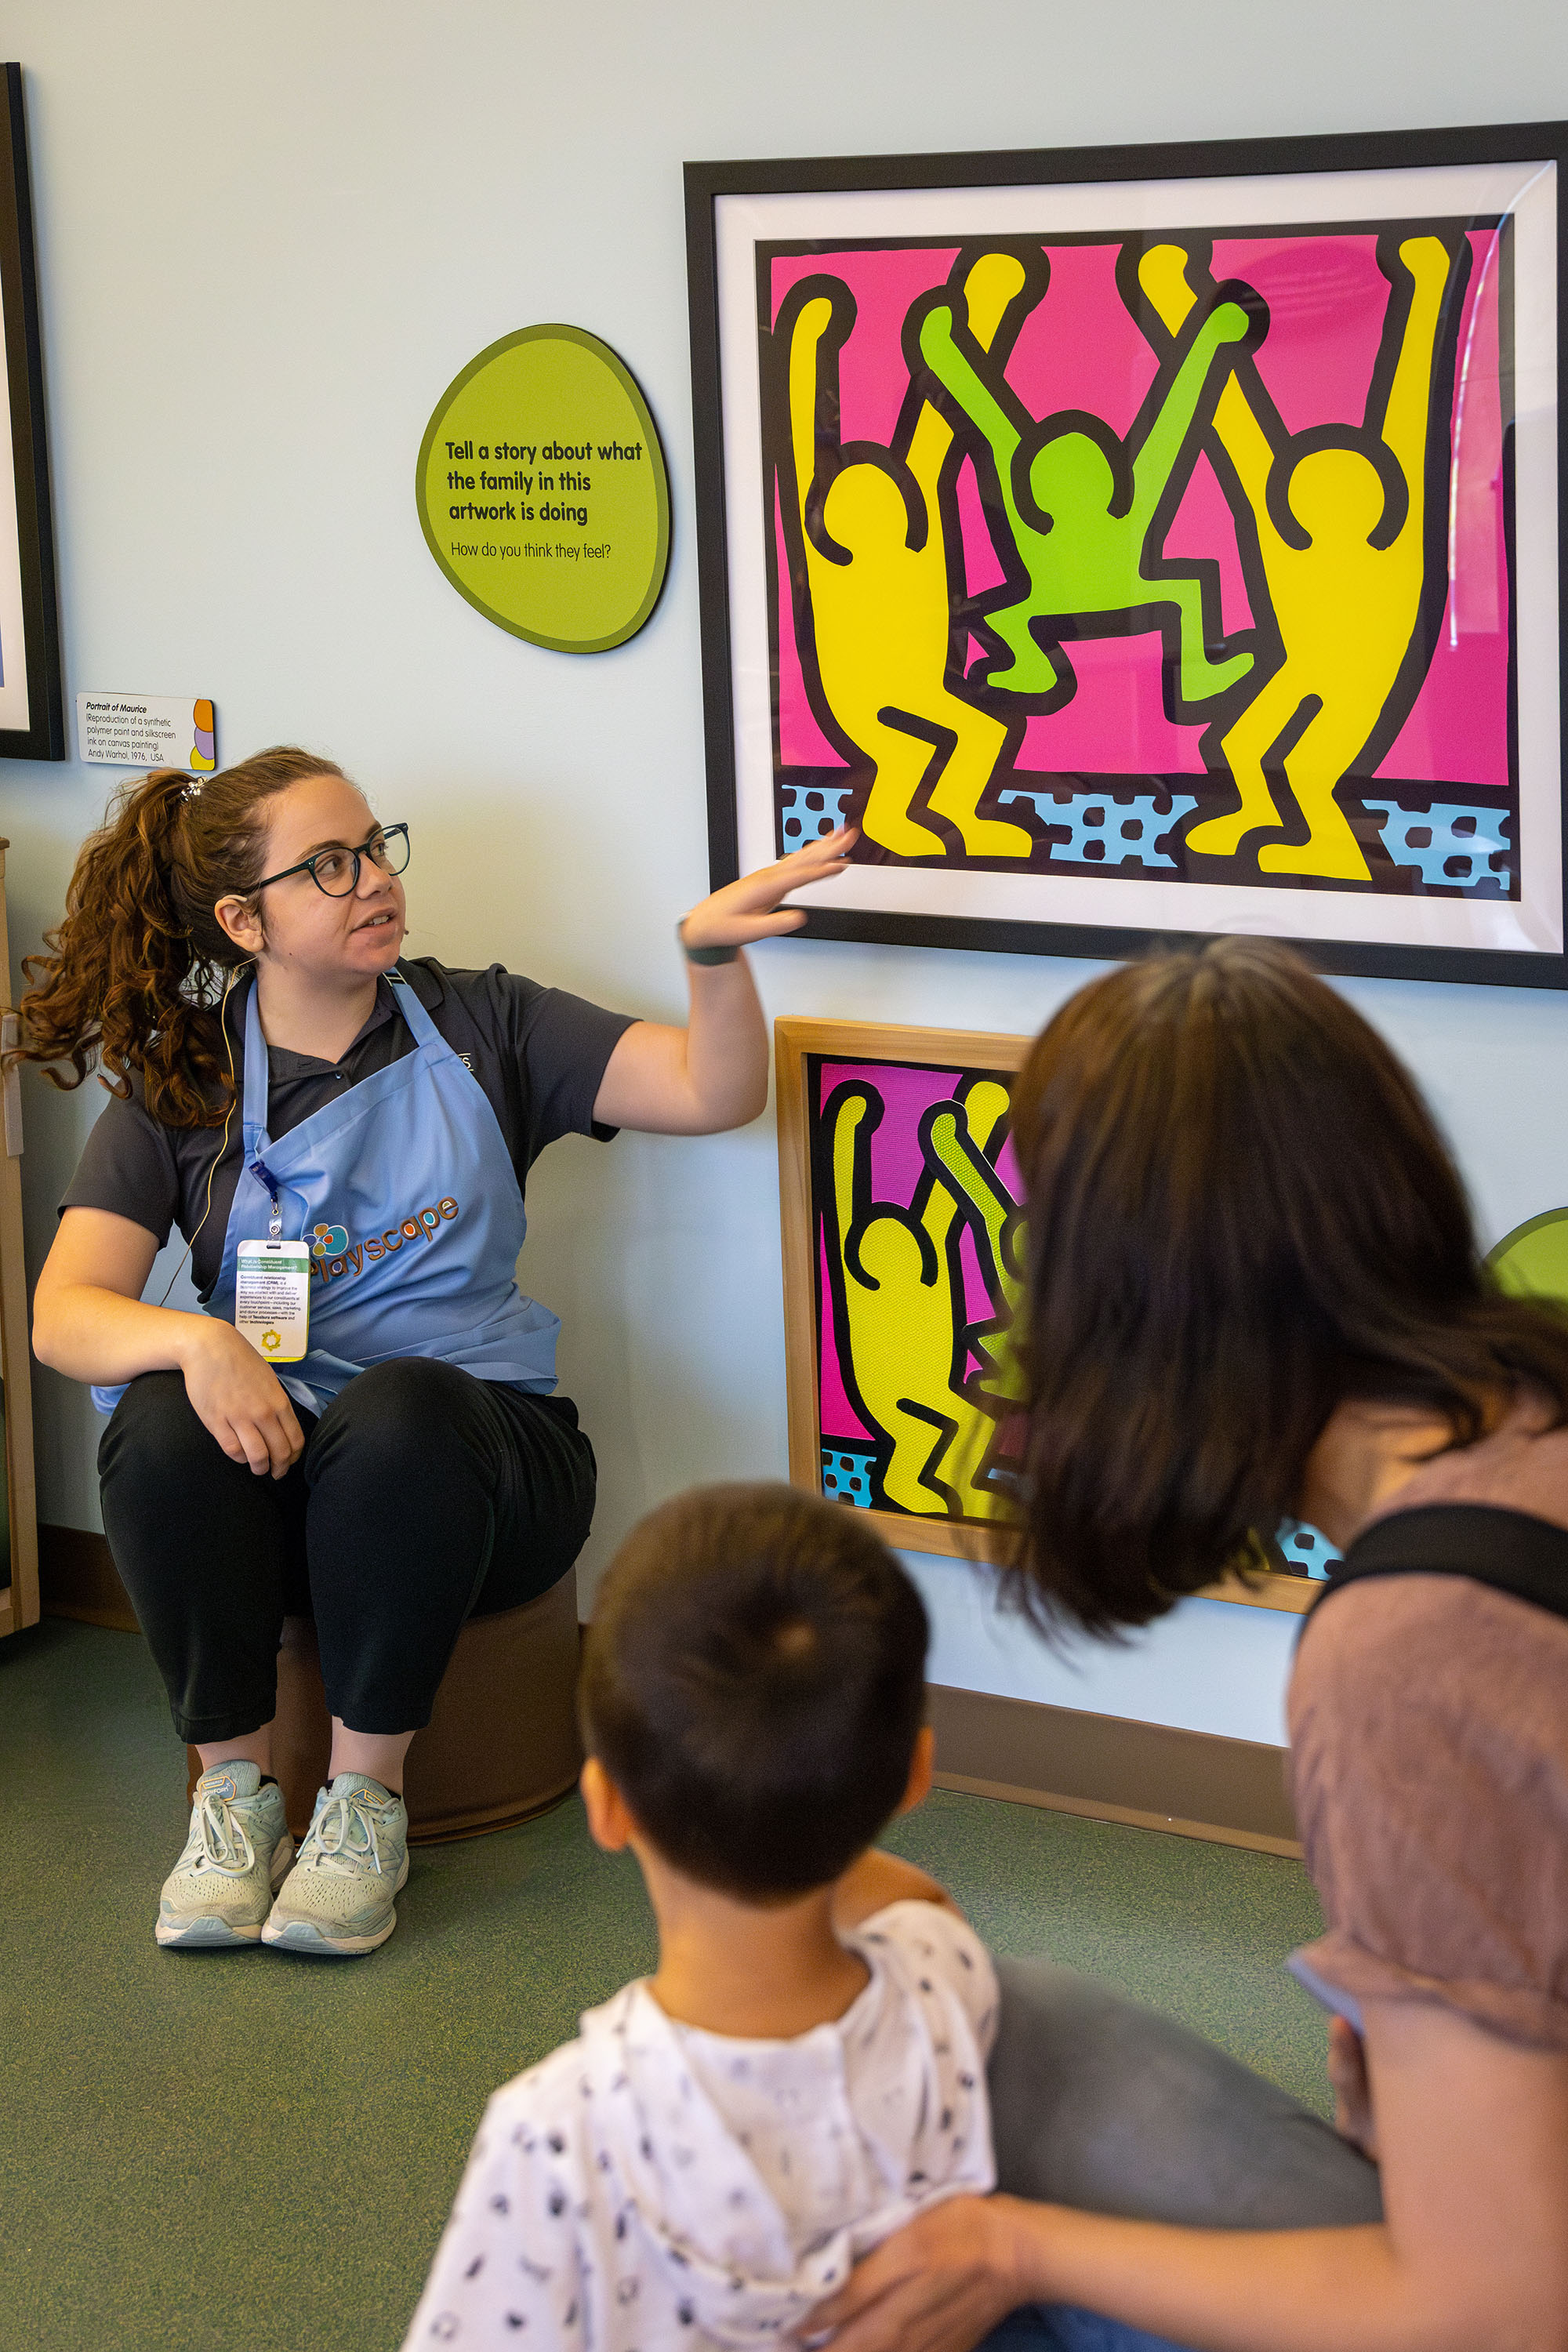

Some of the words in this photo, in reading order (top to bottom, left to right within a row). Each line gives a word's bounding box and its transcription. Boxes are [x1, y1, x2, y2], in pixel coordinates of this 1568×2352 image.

[445, 441, 473, 459] Tell
[478, 446, 488, 459] a
[495, 443, 536, 465] story
[542, 441, 593, 460] about
[597, 441, 642, 460] what
[447, 470, 475, 490] the
[480, 470, 533, 495] family
[539, 471, 554, 490] in
[559, 472, 590, 491] this
[449, 502, 516, 520] artwork
[521, 503, 534, 521] is
[539, 503, 587, 526] doing
[451, 542, 478, 556] How
[481, 542, 496, 557] do
[500, 546, 521, 560] you
[524, 543, 552, 557] think
[555, 543, 579, 561] they
[583, 543, 611, 558] feel?
[86, 702, 110, 710] Portrait
[86, 714, 129, 724] (Reproduction
[144, 717, 171, 727] synthetic
[87, 726, 112, 735] polymer
[145, 730, 176, 738] silkscreen
[132, 741, 159, 751] painting)
[88, 749, 104, 758] Andy
[106, 750, 129, 760] Warhol,
[131, 752, 147, 761] 1976,
